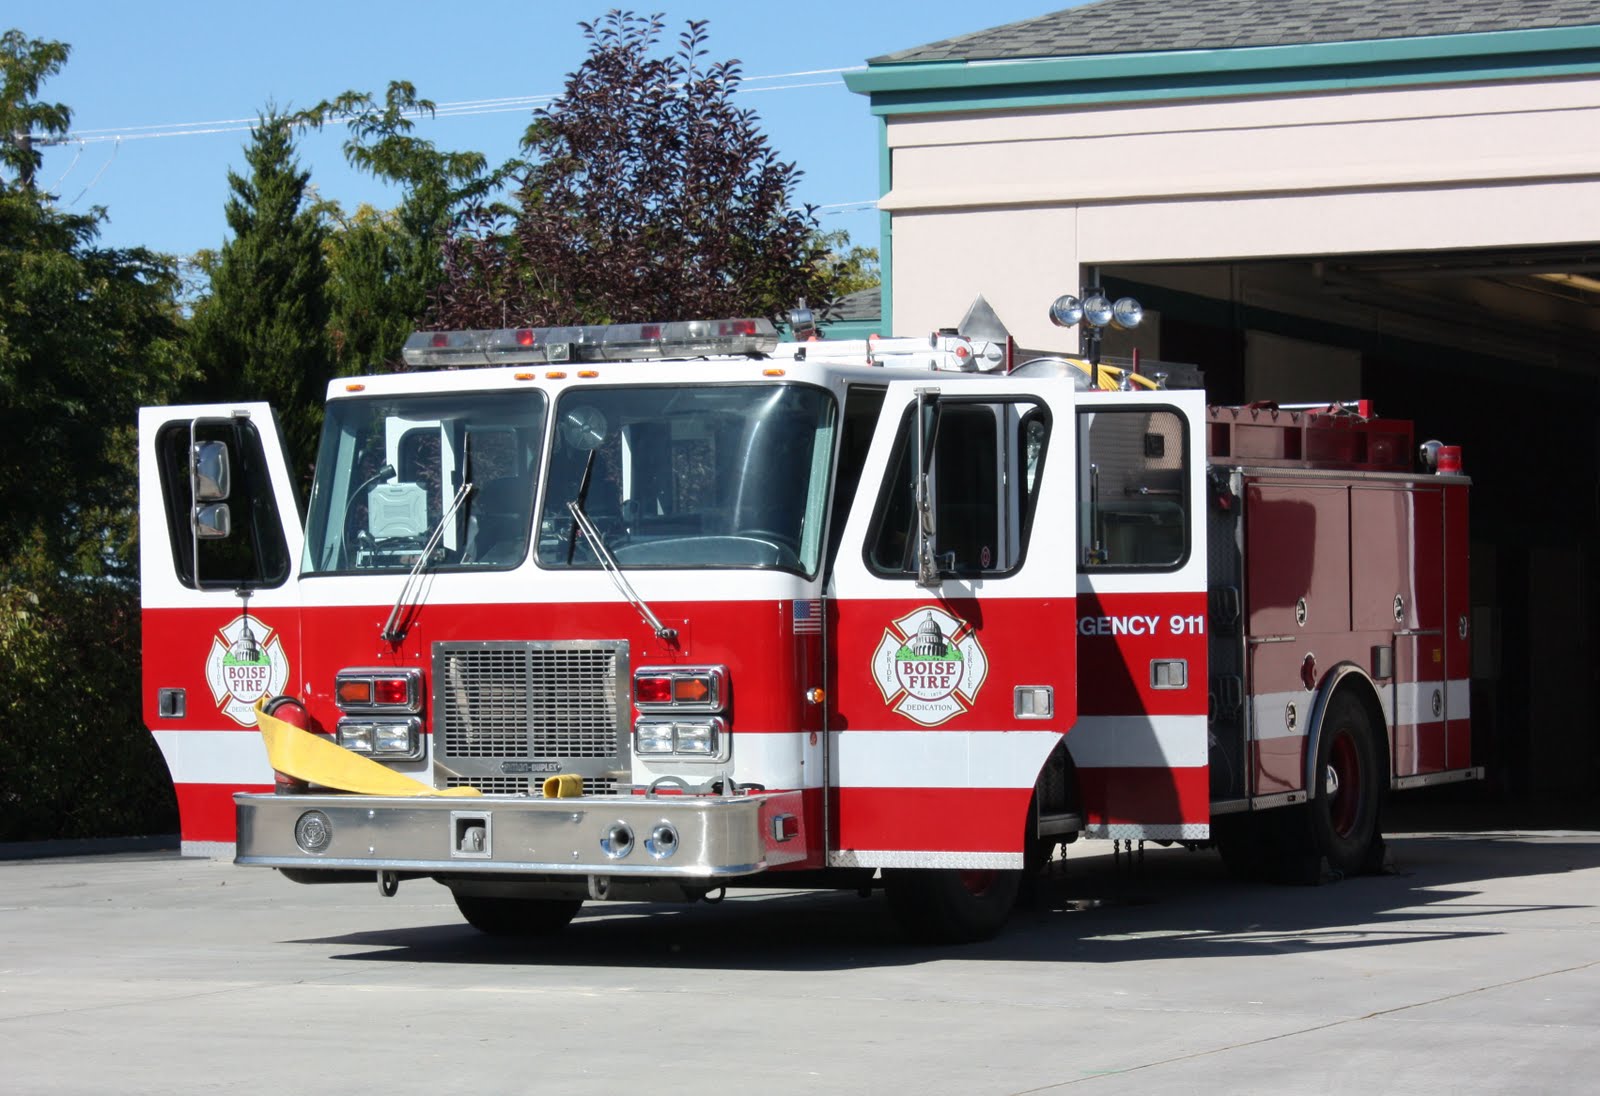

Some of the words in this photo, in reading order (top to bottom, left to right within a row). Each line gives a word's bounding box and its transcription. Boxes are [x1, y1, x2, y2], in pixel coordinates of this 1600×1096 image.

[1076, 615, 1160, 636] GENCY
[1169, 615, 1204, 635] 911
[229, 666, 266, 679] BOISE
[903, 662, 956, 675] BOISE
[233, 680, 263, 692] FIRE
[908, 676, 951, 689] FIRE
